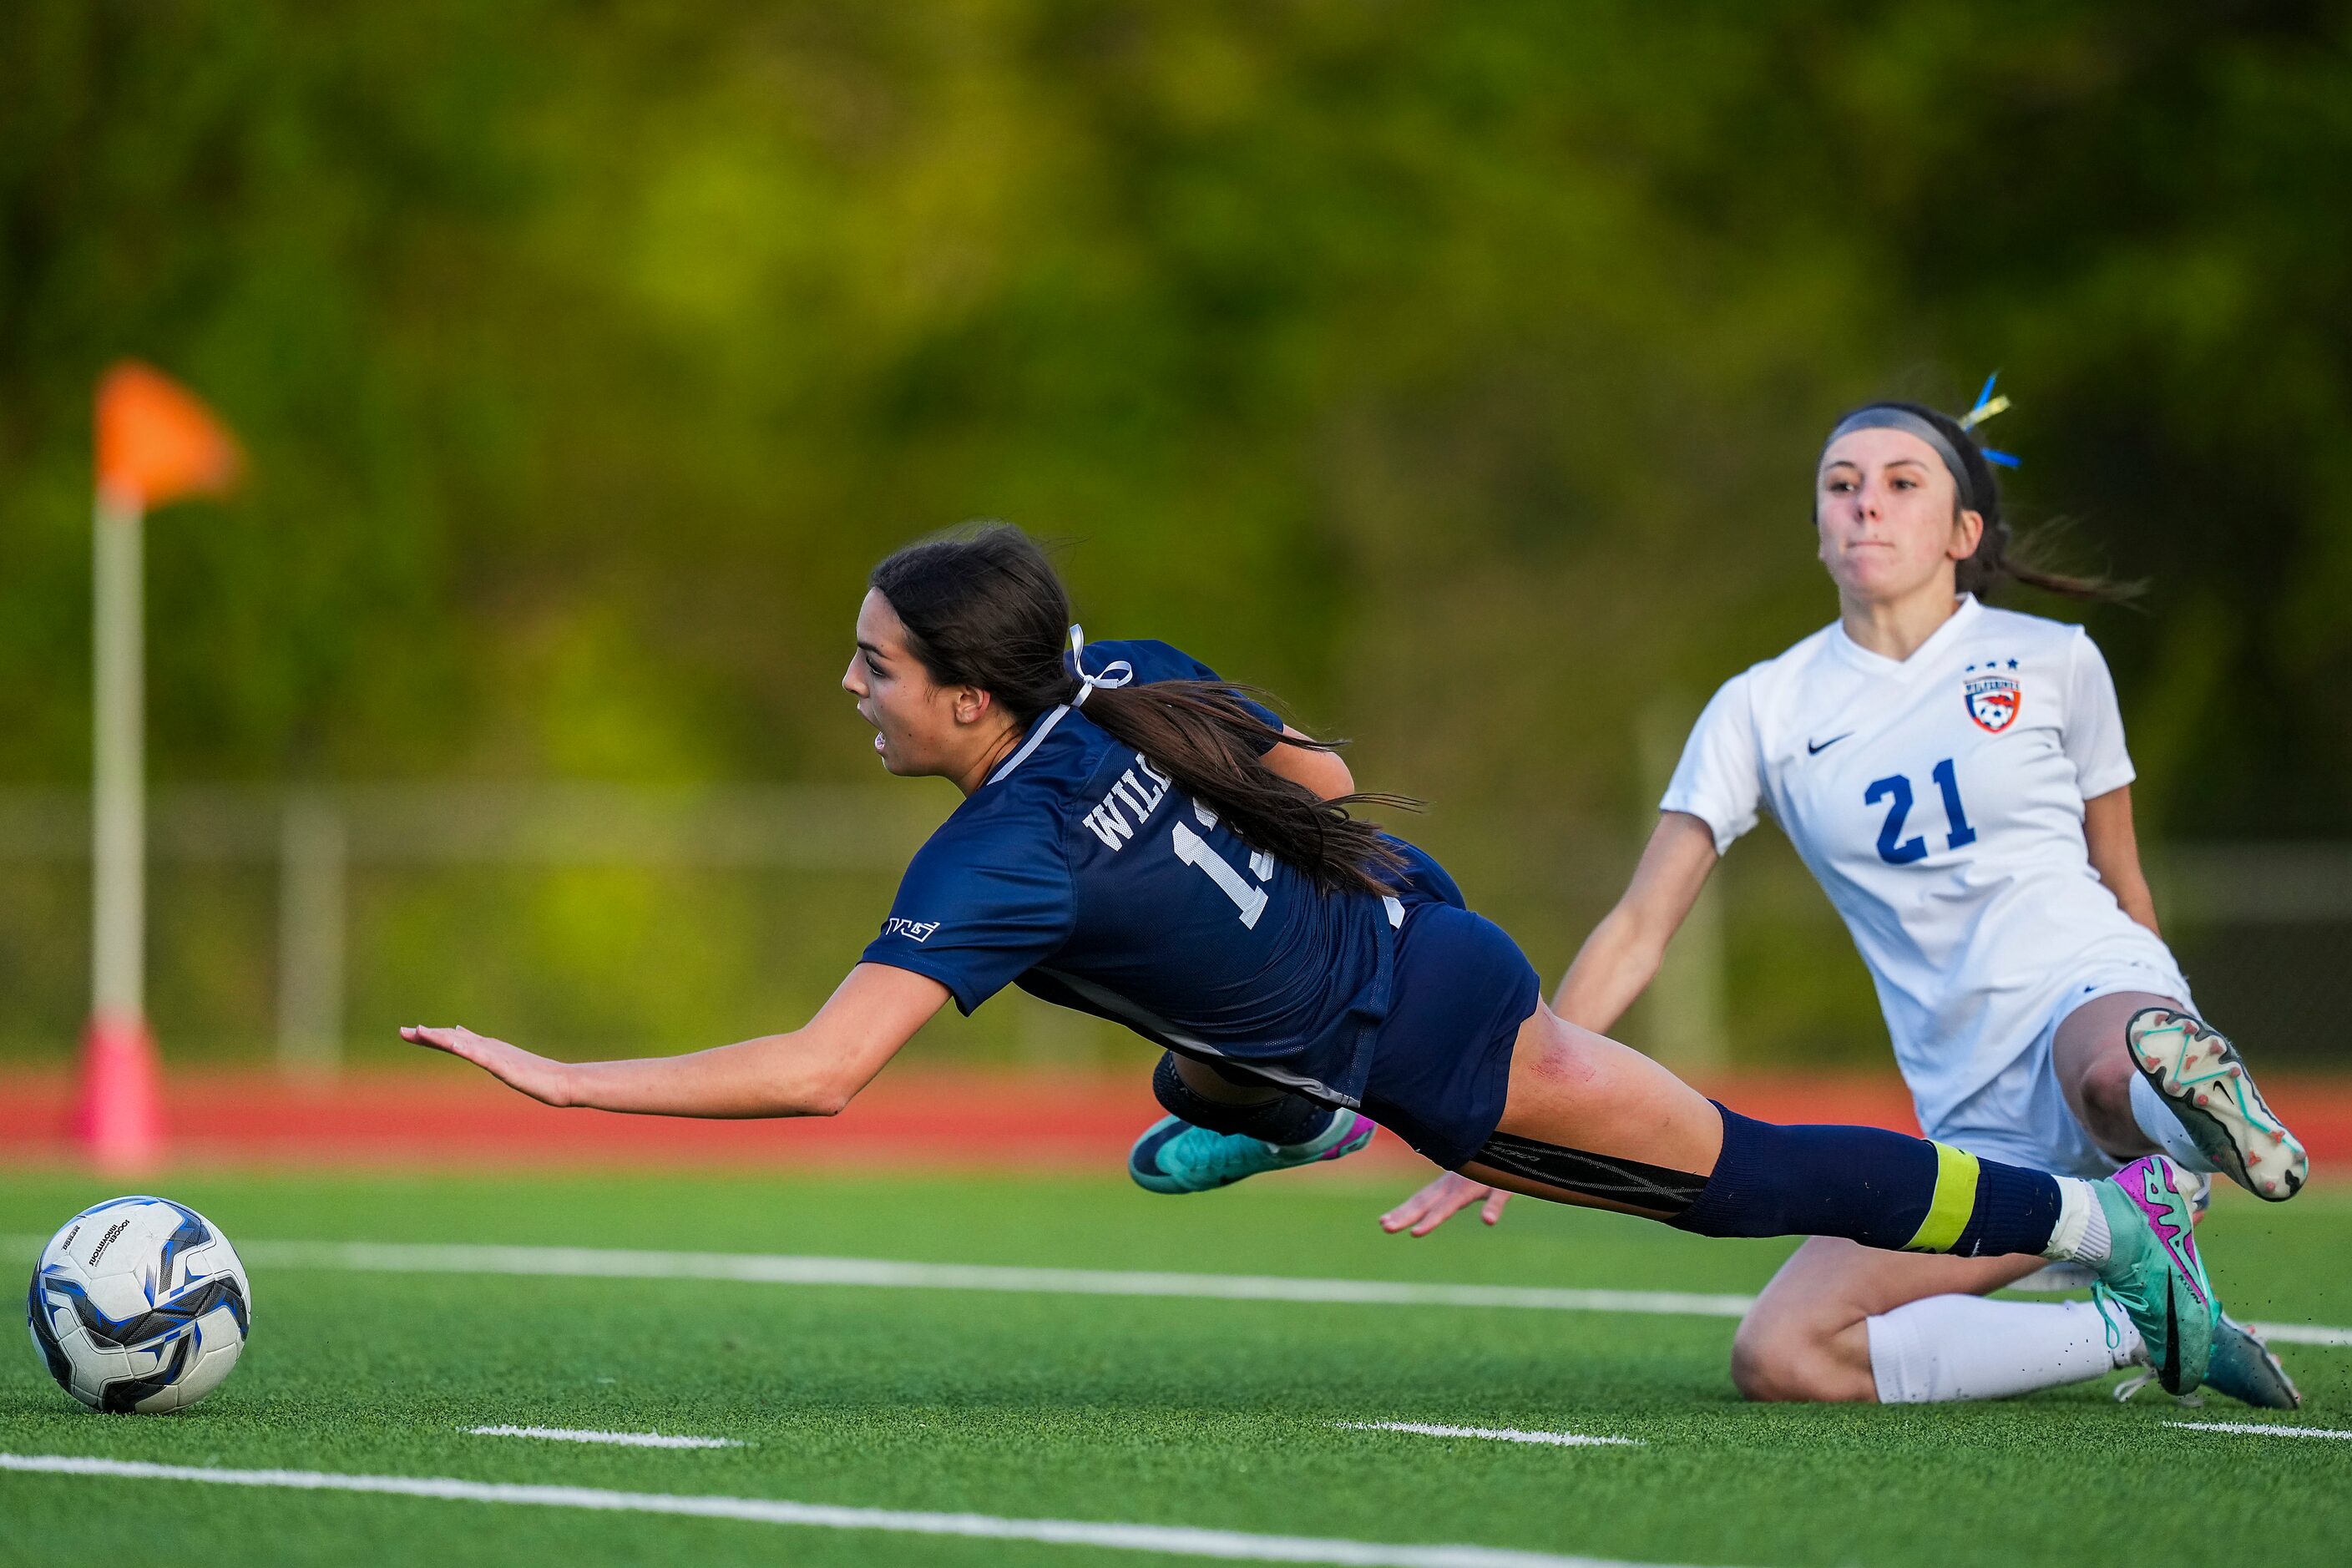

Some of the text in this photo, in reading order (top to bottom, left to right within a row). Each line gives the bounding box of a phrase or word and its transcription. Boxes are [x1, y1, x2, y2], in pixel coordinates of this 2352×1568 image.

[1171, 797, 1276, 930] 1
[1864, 756, 1976, 865] 21
[109, 1219, 130, 1244] SOCCER
